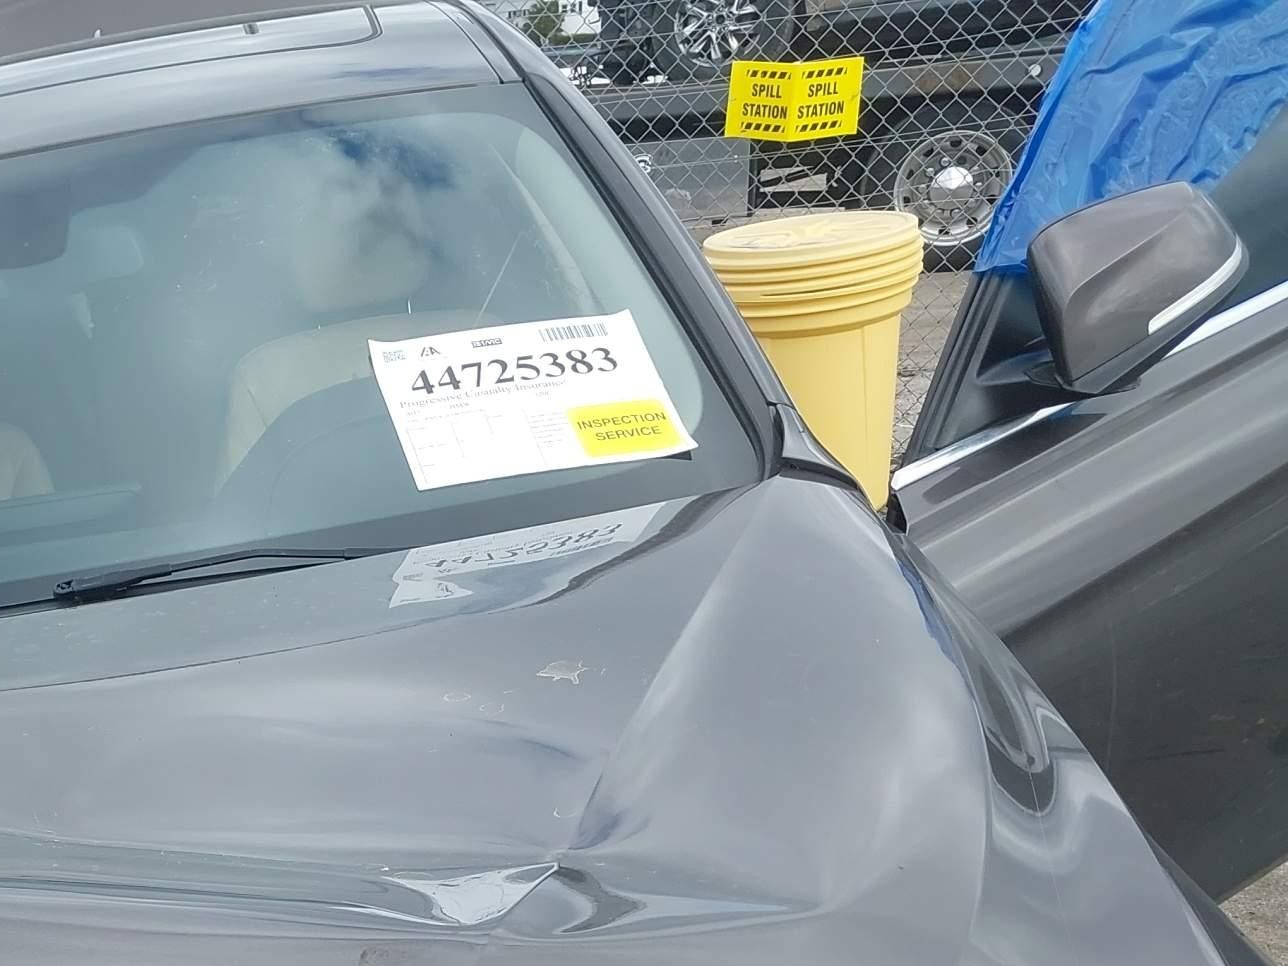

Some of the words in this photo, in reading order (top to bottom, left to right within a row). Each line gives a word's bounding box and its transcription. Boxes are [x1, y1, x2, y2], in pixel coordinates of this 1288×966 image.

[751, 83, 782, 98] SPILL
[808, 82, 838, 98] SPILL
[742, 103, 788, 119] STATION
[797, 101, 844, 119] STATION
[410, 347, 619, 394] 44725383
[576, 411, 667, 430] INSPECTION
[596, 426, 662, 442] SERVICE
